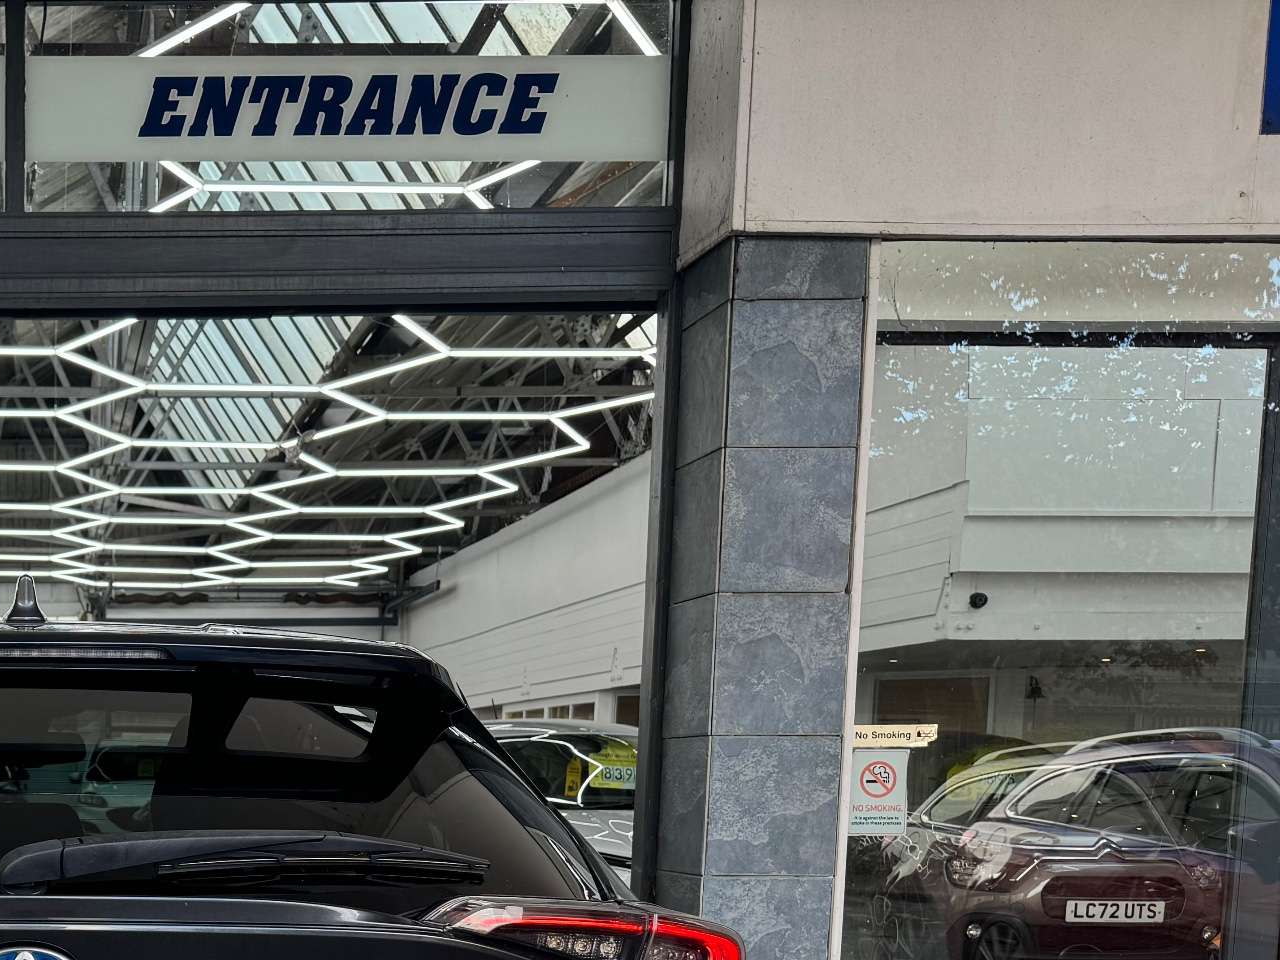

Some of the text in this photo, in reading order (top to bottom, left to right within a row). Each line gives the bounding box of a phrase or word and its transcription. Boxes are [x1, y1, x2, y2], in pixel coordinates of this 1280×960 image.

[137, 72, 560, 137] ENTRANCE
[855, 731, 911, 740] No Smoking
[852, 804, 864, 812] NO
[1074, 902, 1157, 919] LC72 UTS
